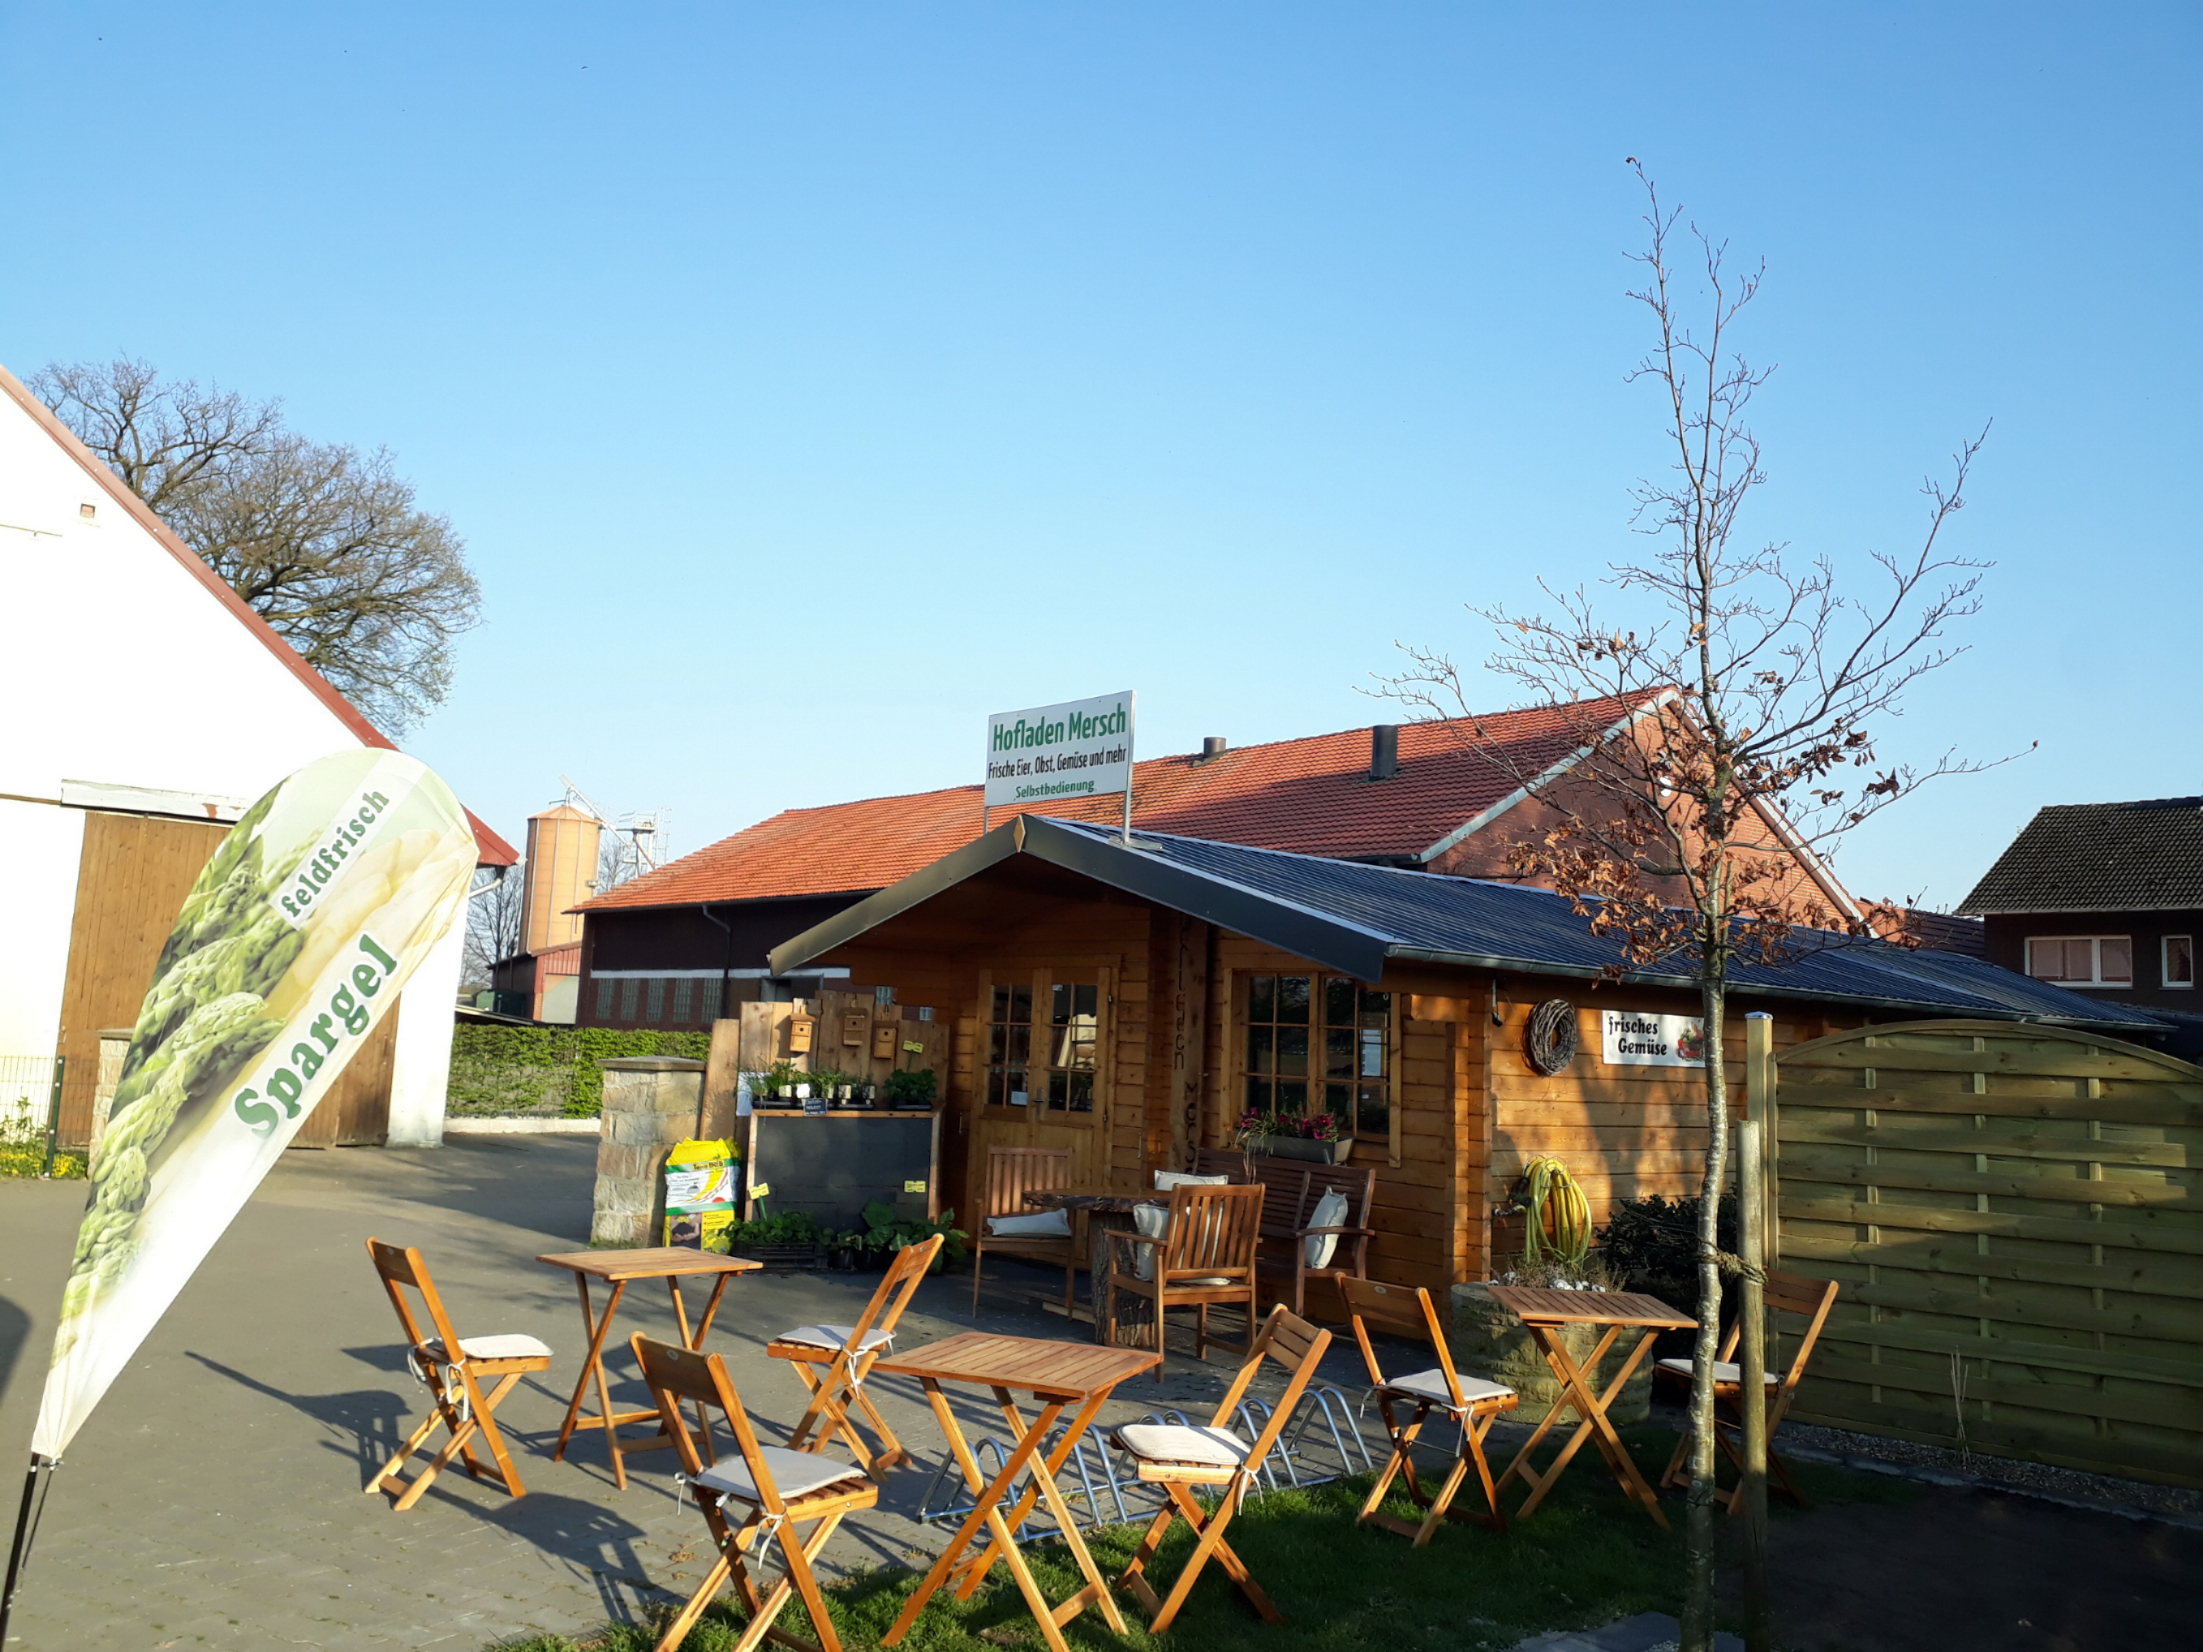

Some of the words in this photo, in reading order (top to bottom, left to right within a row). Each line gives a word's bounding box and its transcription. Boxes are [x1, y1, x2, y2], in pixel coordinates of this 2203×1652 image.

[993, 716, 1064, 751] Hofladen
[1068, 703, 1126, 741] Mersch
[988, 759, 1015, 780] Frische
[1017, 758, 1033, 776] Eier,
[1035, 754, 1056, 774] Obst,
[1057, 751, 1088, 771] Gemüse
[1089, 746, 1104, 766] und
[1106, 743, 1127, 764] mehr
[1016, 780, 1095, 798] Selbstbedienung
[280, 790, 390, 918] feldfrisch
[234, 933, 398, 1140] Spargel
[1609, 1015, 1658, 1035] frisches
[1618, 1038, 1667, 1055] Gemüse
[1184, 1081, 1199, 1174] Mers
